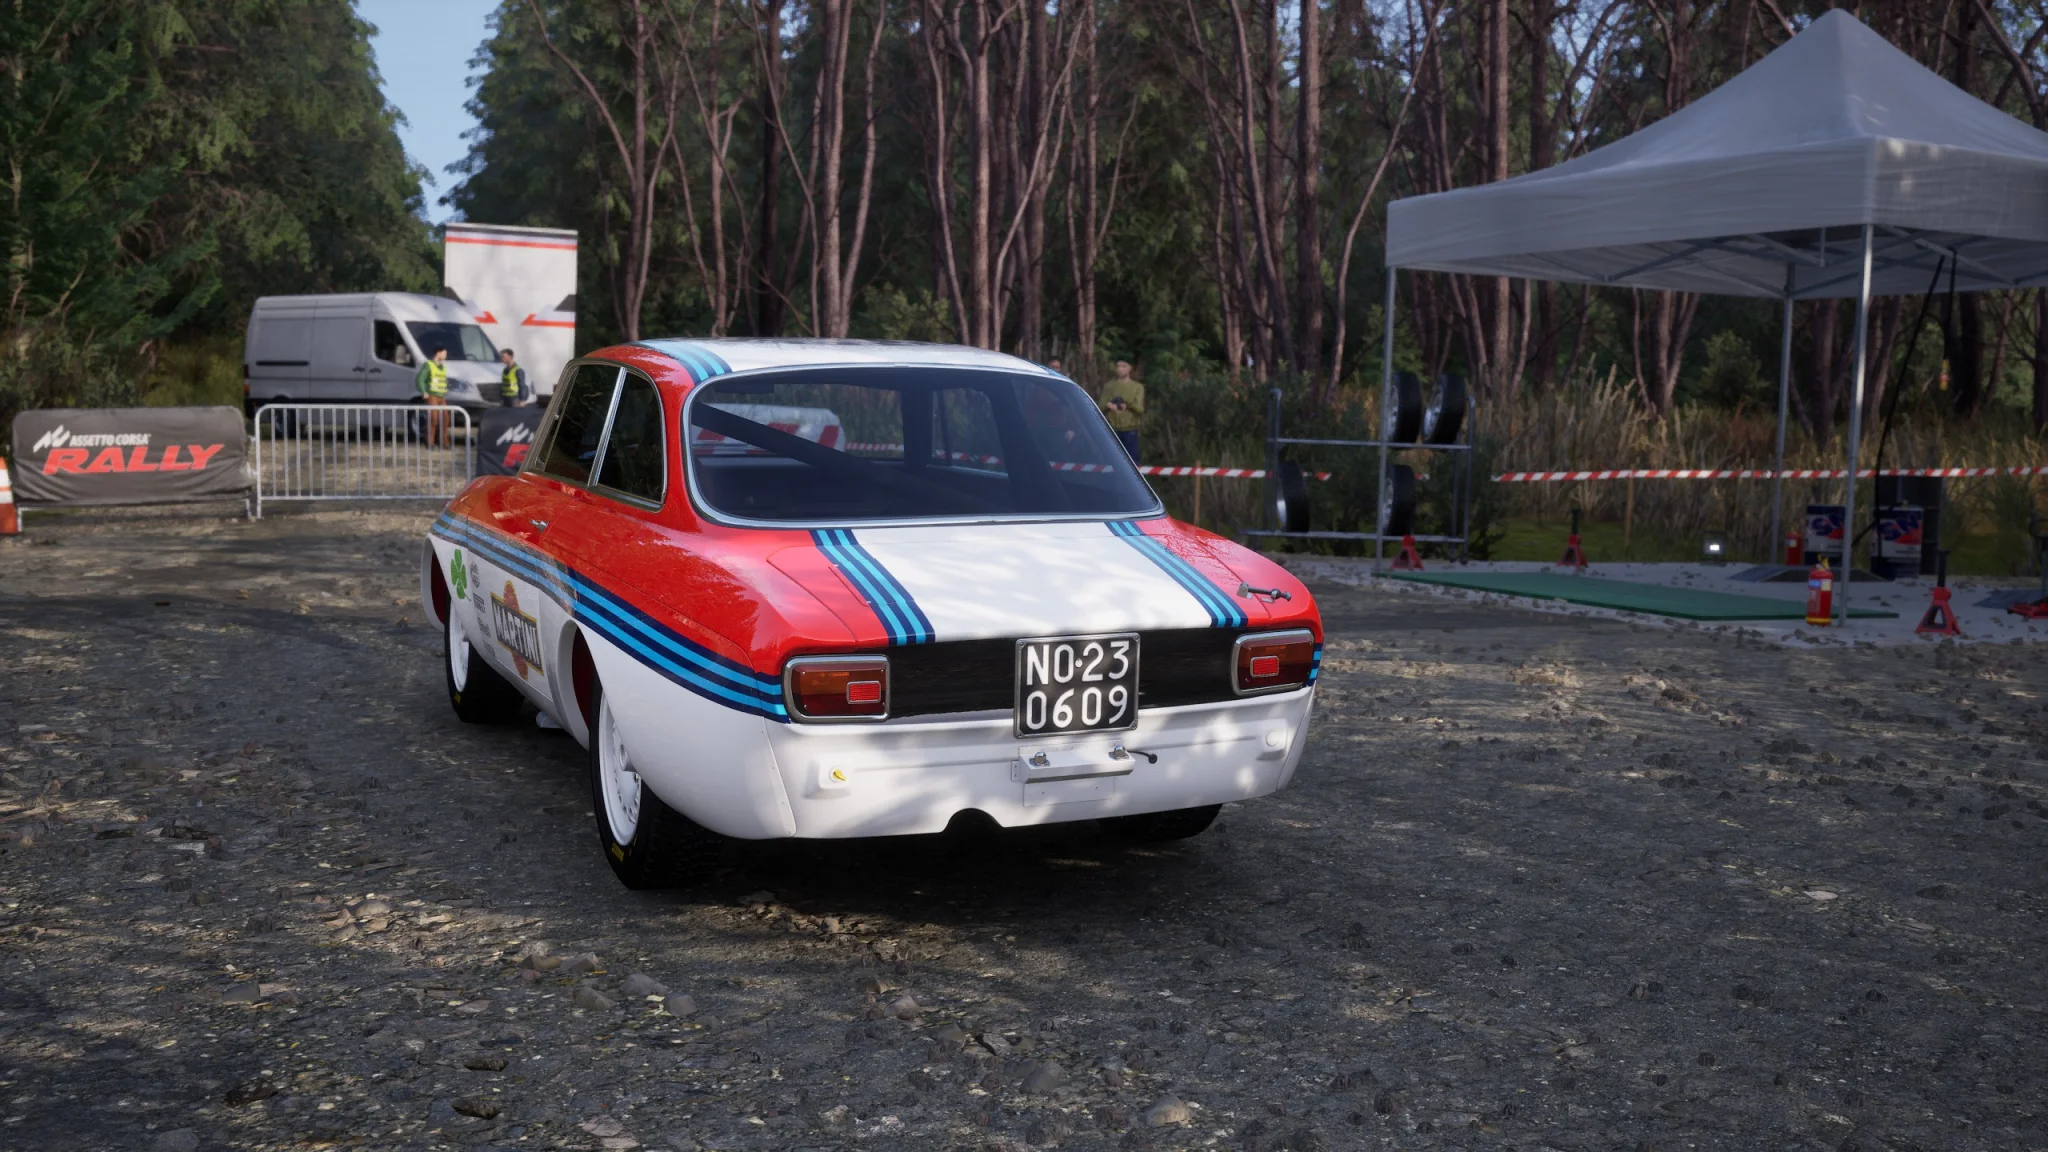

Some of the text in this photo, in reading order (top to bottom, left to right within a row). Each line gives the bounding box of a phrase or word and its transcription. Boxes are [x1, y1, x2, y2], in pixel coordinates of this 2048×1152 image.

[69, 433, 148, 447] ASSETTO CORSA
[42, 444, 225, 476] RALLY
[492, 600, 541, 665] MARTINI
[1026, 685, 1128, 730] 0609
